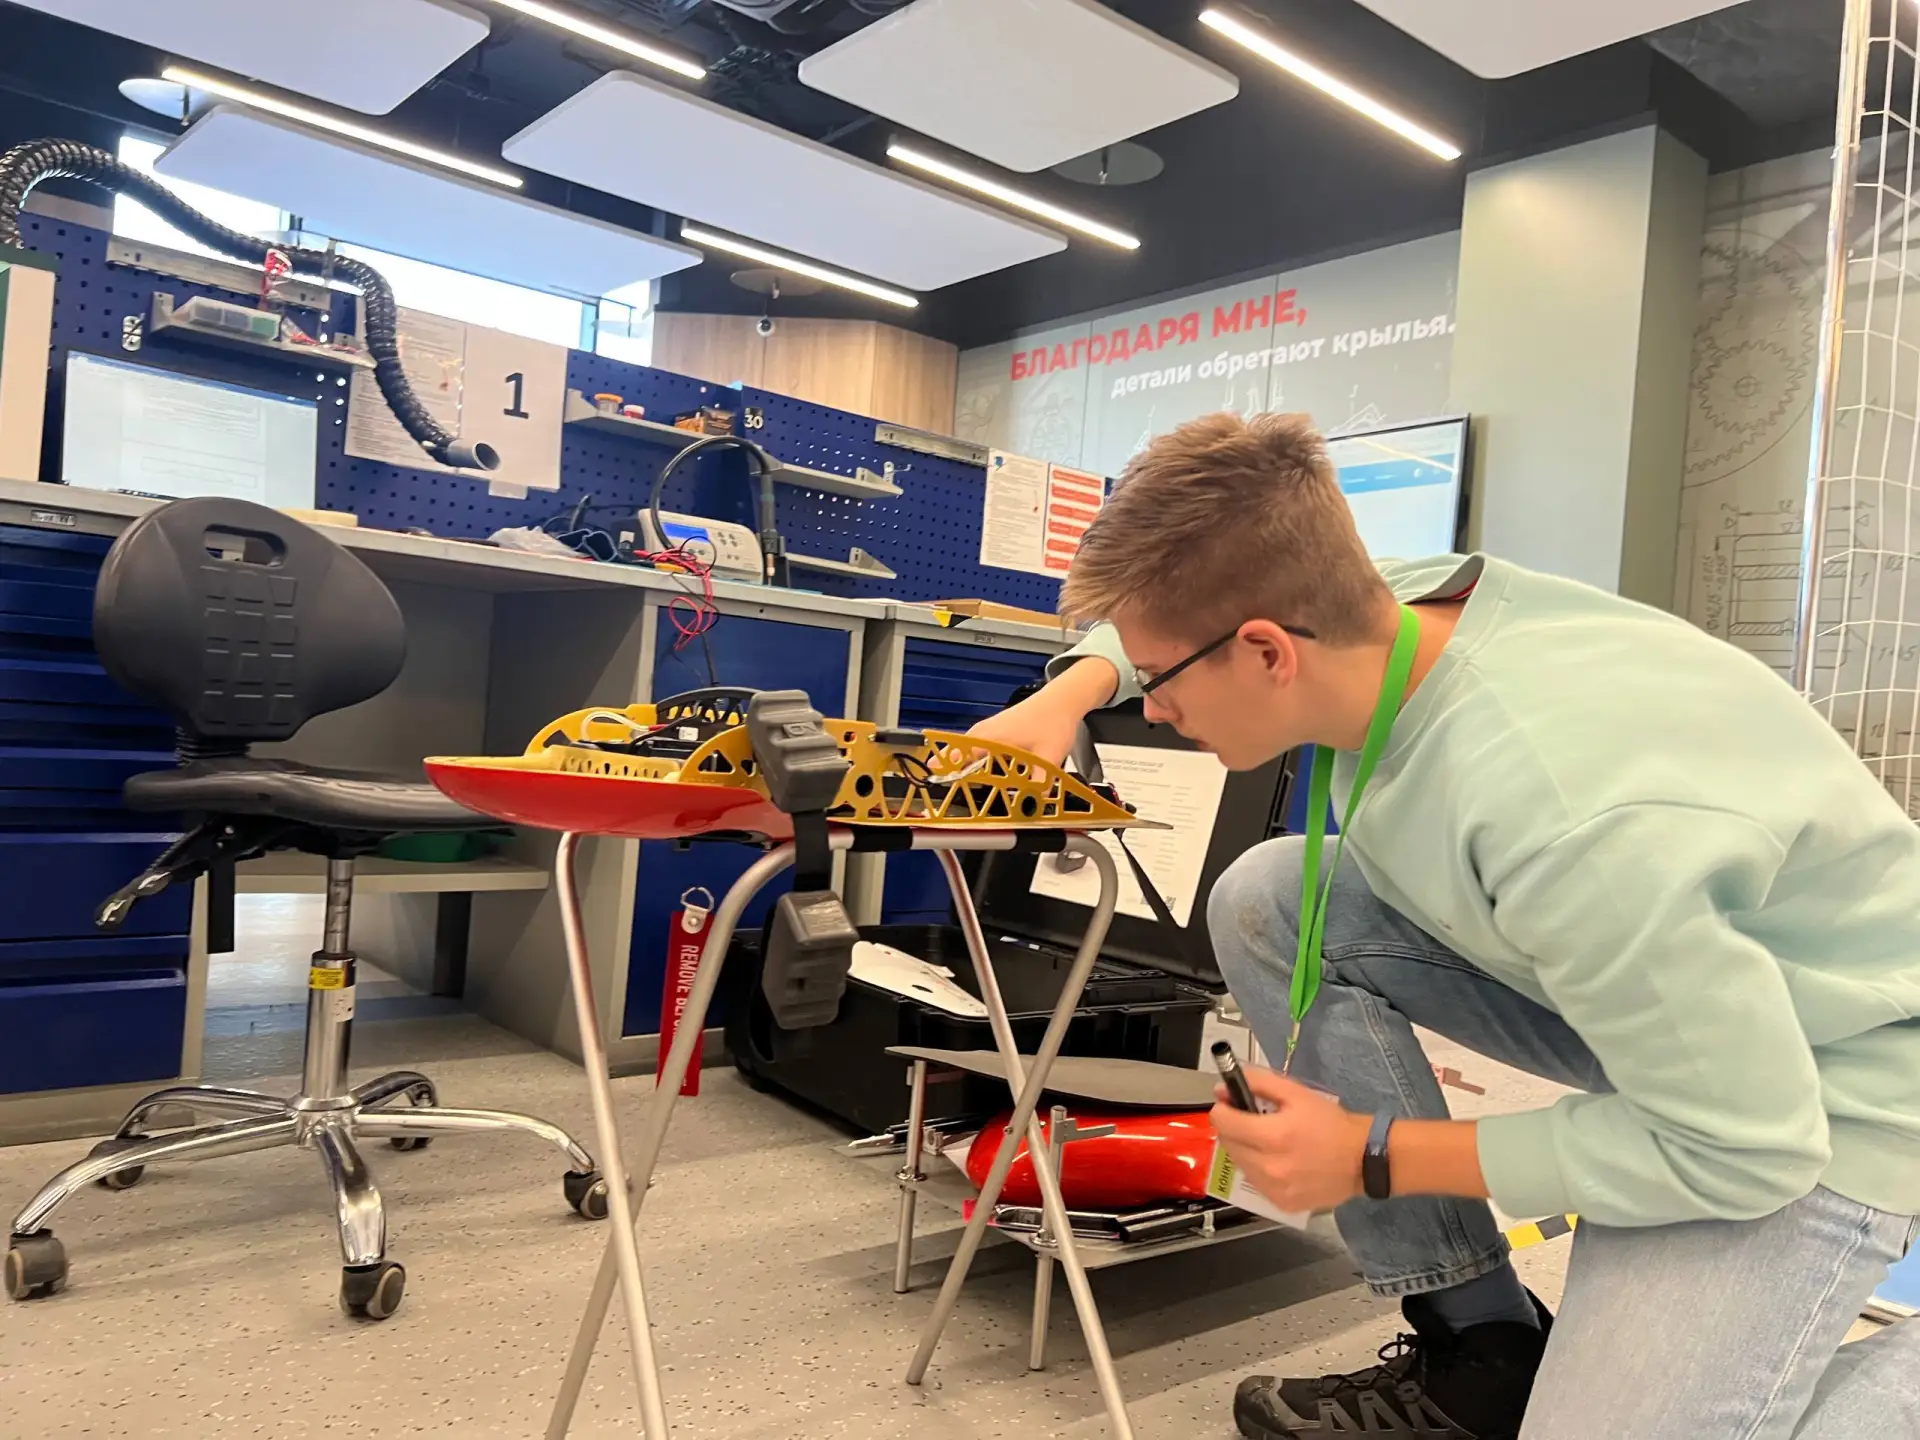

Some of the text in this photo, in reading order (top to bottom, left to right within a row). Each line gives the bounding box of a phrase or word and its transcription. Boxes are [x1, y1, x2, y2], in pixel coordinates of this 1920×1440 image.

[1009, 289, 1307, 382] БЛАГОДАРЯ МНЕ,
[1111, 315, 1456, 400] детали обретают крылья.
[503, 372, 529, 419] 1
[744, 414, 764, 429] 30
[676, 944, 700, 993] REMOVE
[1217, 1152, 1234, 1193] КОНКУ
